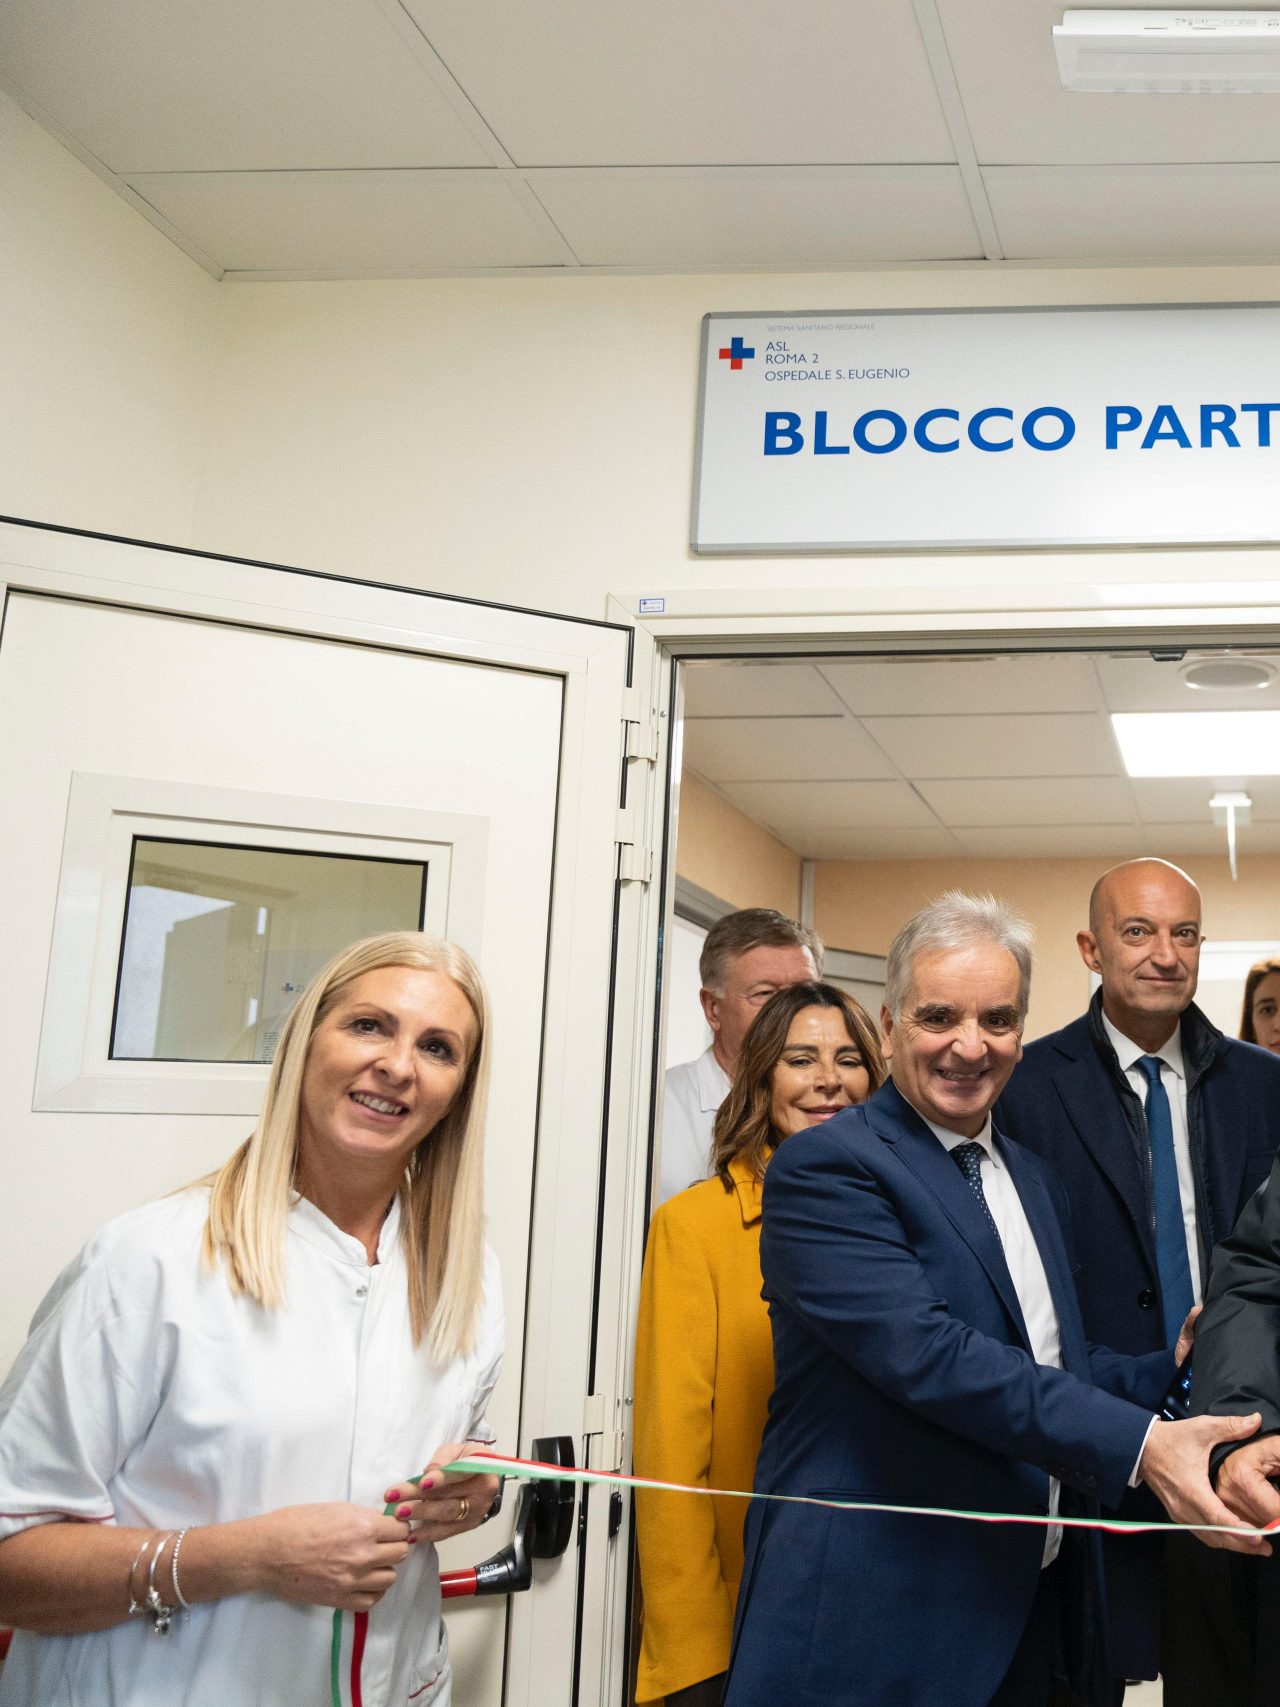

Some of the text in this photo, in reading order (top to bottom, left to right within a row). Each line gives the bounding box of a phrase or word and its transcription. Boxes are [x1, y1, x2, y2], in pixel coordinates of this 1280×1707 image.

[766, 325, 795, 333] SISTEMA
[835, 323, 876, 331] REGIONALE
[765, 341, 790, 352] ASL
[765, 353, 820, 364] ROMA 2
[764, 368, 911, 381] OSPEDALE S. EUGENIO
[763, 406, 1077, 456] BLOCCO
